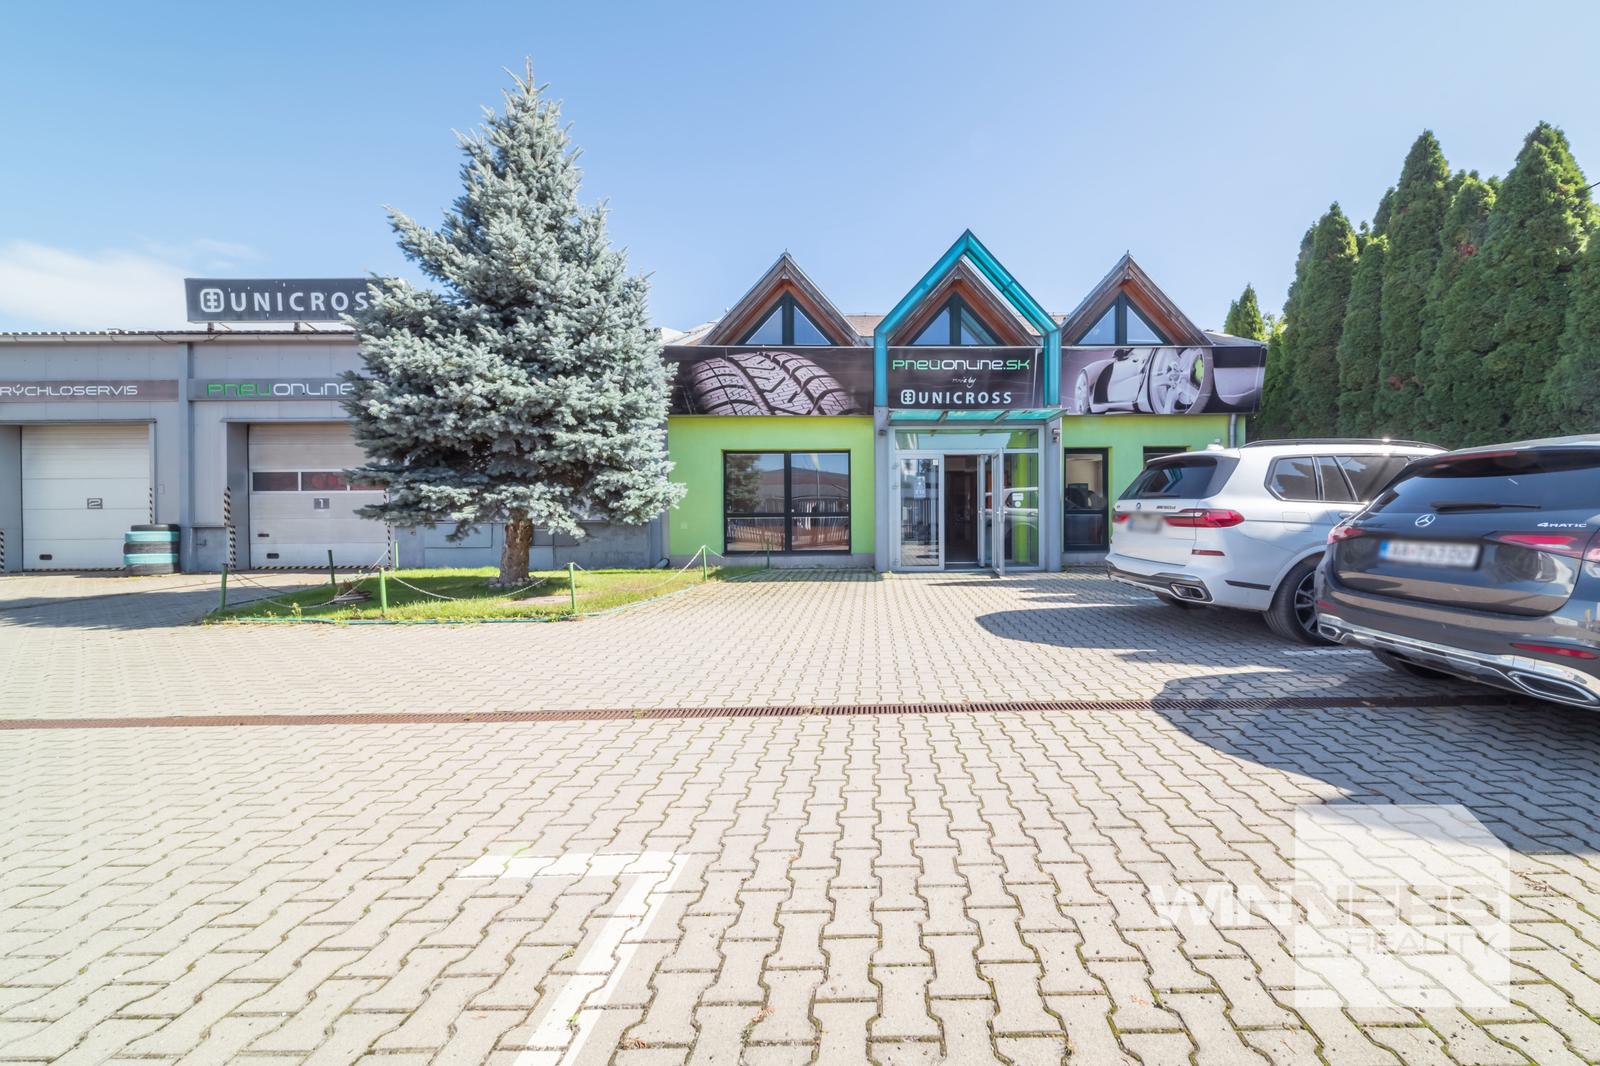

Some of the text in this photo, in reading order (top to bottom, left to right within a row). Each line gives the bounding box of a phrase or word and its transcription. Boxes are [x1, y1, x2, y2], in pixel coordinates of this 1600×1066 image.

[0, 384, 138, 396] RÝCHLOSERVIS
[919, 391, 1012, 404] UNICROSS
[88, 499, 102, 508] 2
